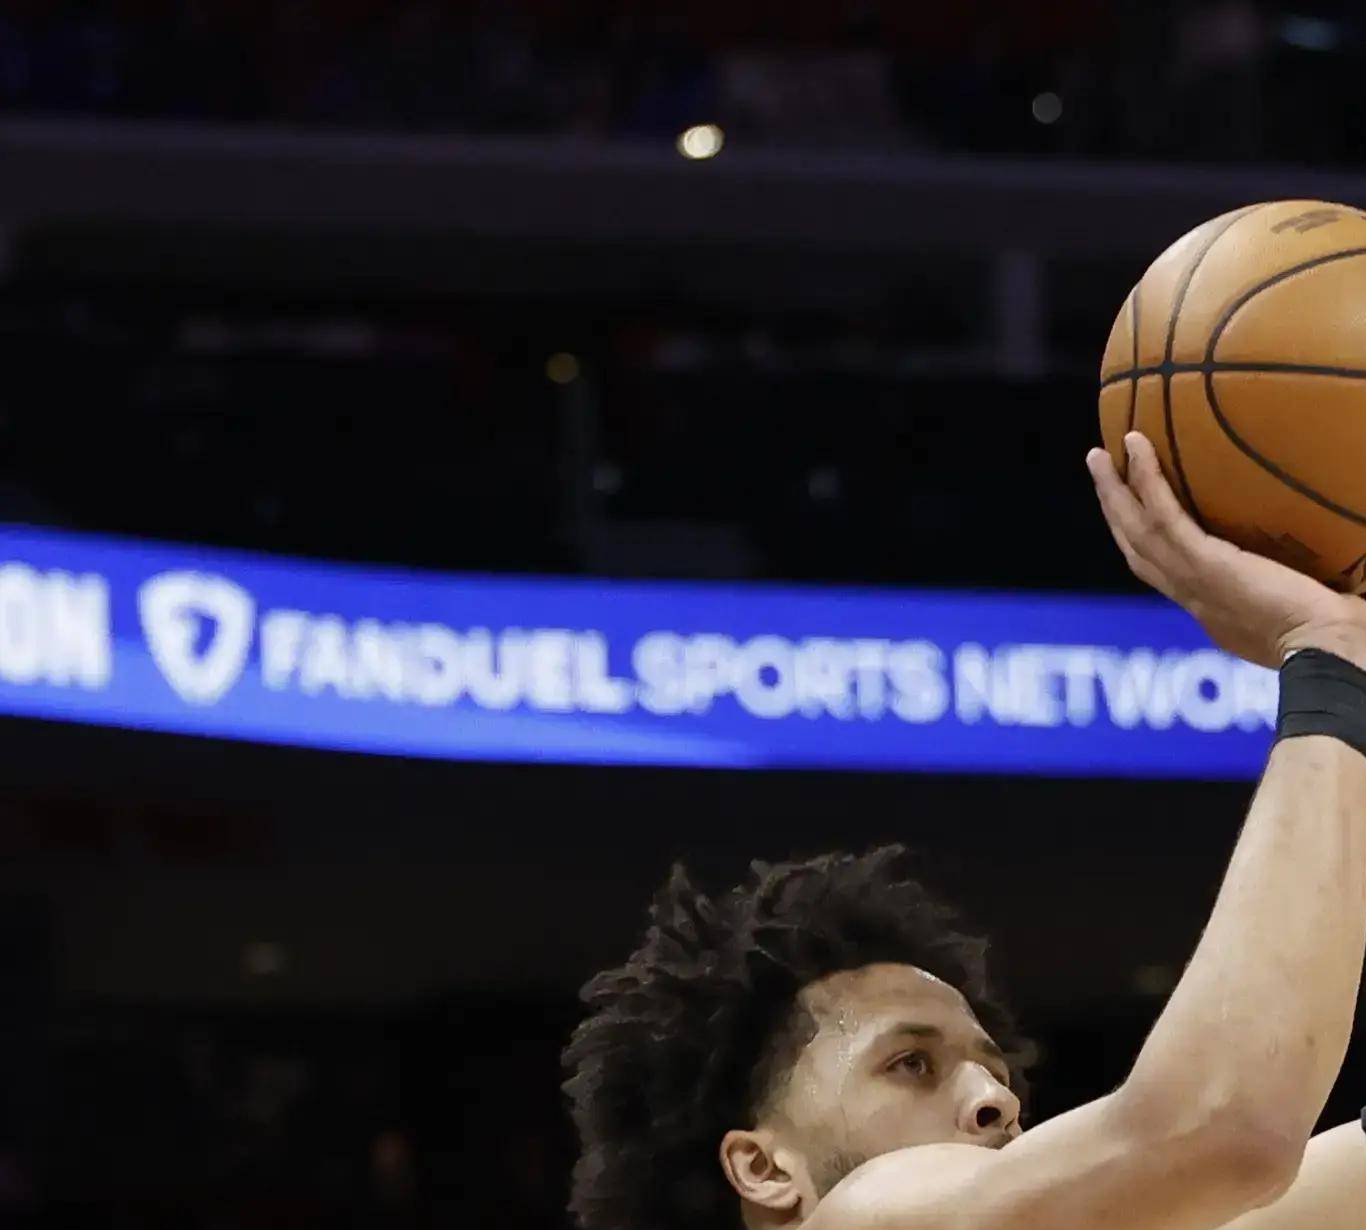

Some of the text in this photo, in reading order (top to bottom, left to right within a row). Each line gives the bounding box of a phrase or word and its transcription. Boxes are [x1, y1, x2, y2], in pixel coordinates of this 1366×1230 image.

[0, 561, 1280, 732] ON FANDUEL SPORTS NETWOR
